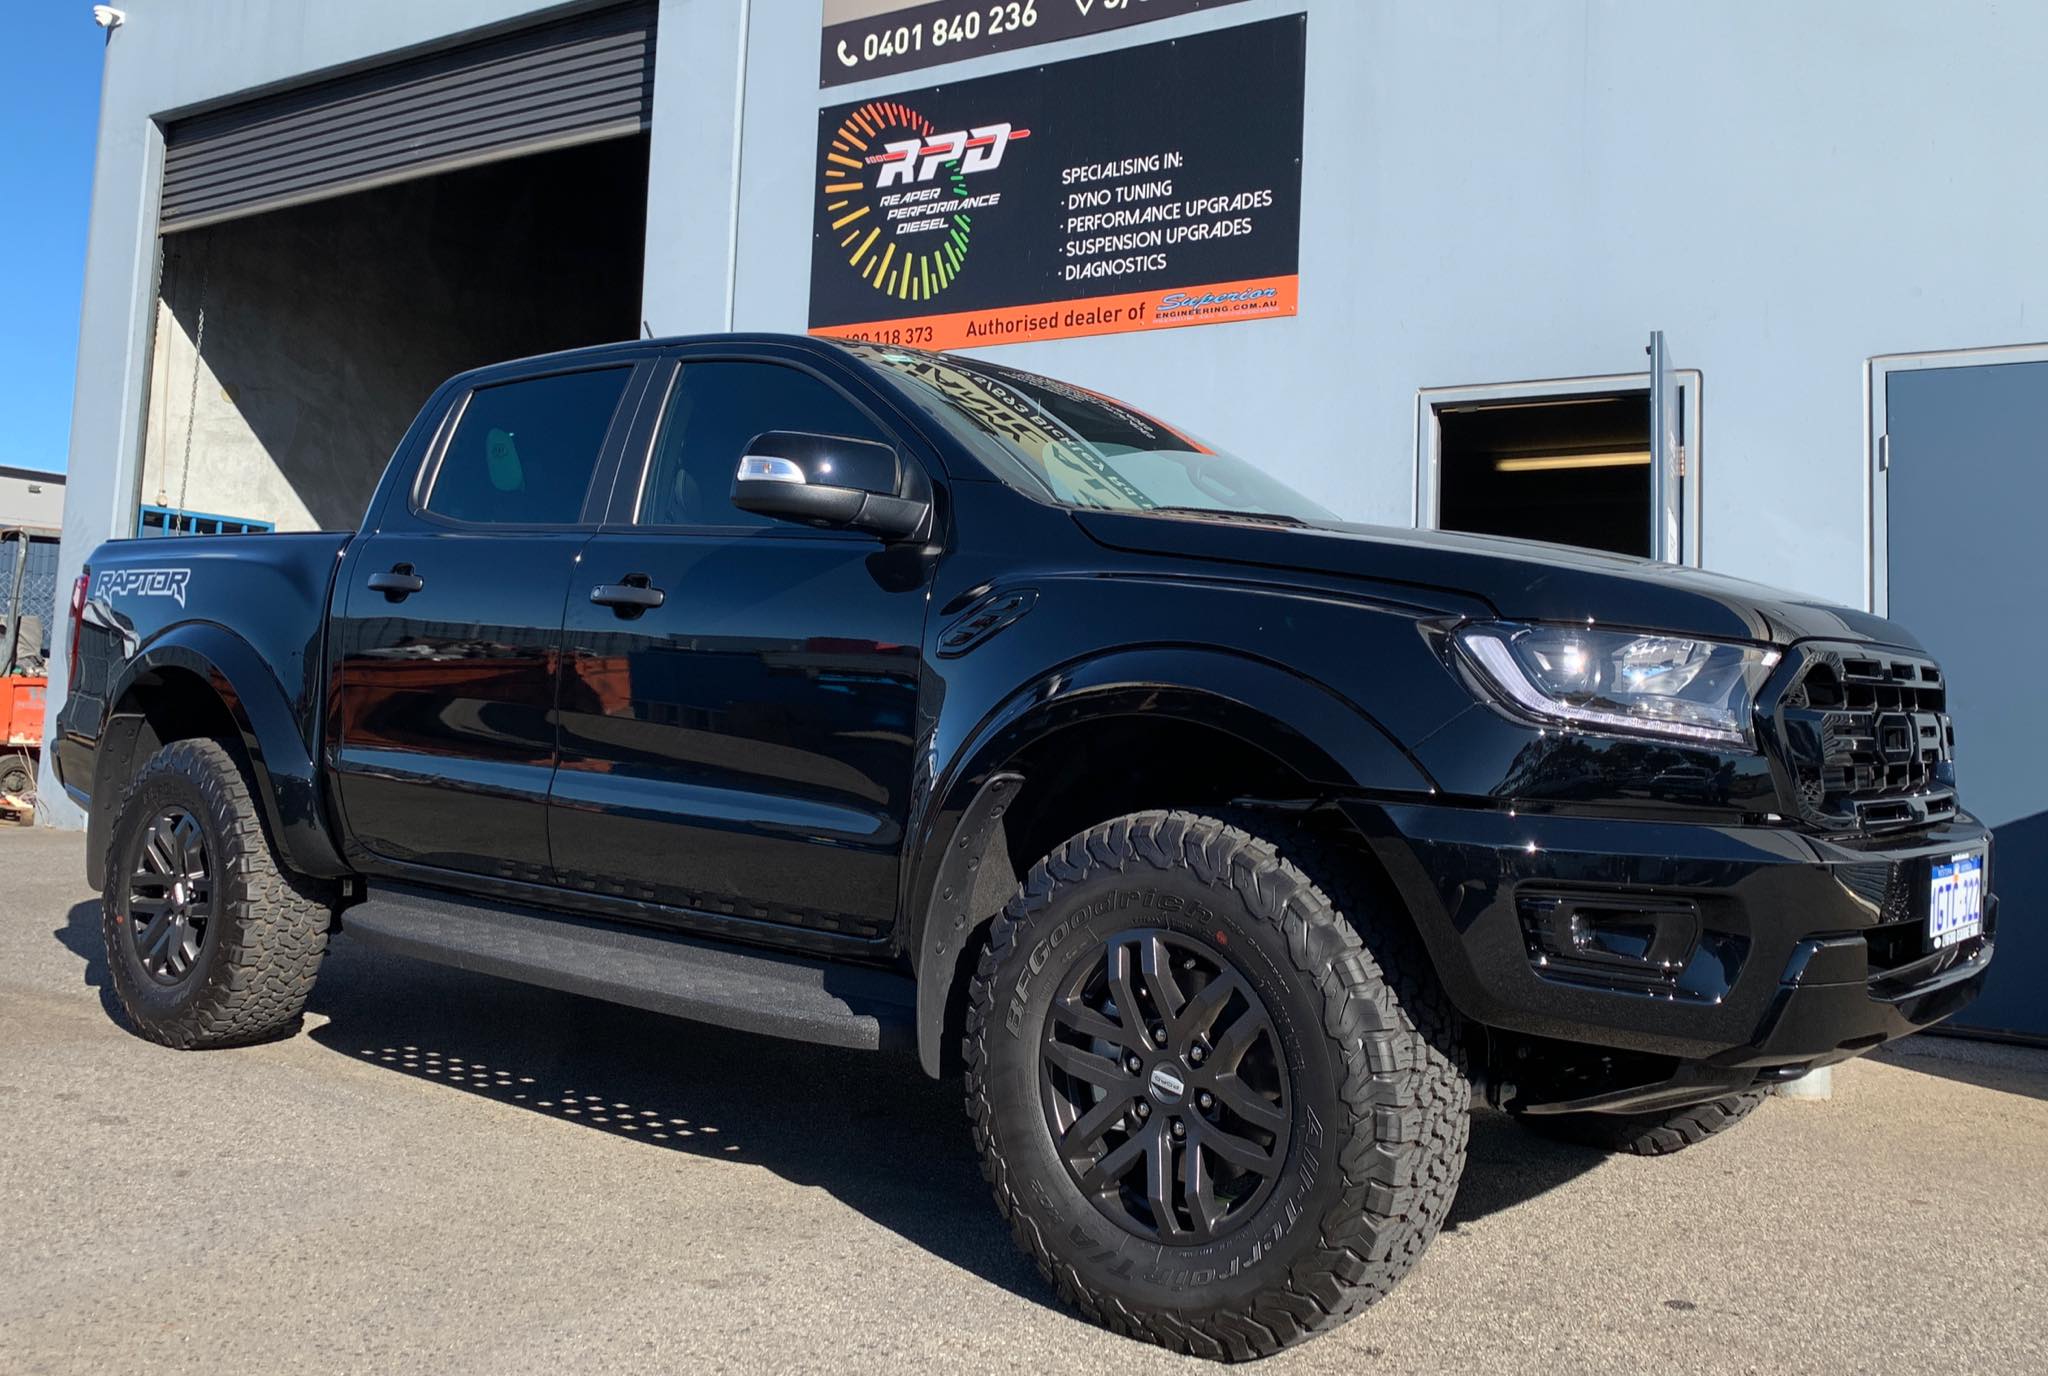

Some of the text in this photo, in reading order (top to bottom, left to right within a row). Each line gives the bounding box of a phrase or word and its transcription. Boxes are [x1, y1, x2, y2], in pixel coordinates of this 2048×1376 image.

[863, 0, 1038, 62] 0401 840 236
[876, 122, 1012, 189] RPD
[1062, 152, 1183, 184] SPECIALISING IN:
[880, 188, 942, 207] REAPER
[887, 193, 1001, 221] PERFORMANCE
[1068, 180, 1173, 210] DYNO TUNING
[896, 218, 949, 235] DIESEL
[1067, 190, 1273, 233] PERFORMANCE UPGRADES
[1066, 218, 1252, 257] SUSPENSION UPGRADES
[1065, 253, 1168, 281] DIAGNOSTICS
[1155, 300, 1278, 319] ENGINEERING.COM.AU
[1157, 287, 1277, 312] Superior
[905, 326, 933, 344] 373
[966, 311, 1059, 338] Authorised
[1064, 306, 1122, 329] dealer
[1128, 302, 1146, 322] of
[95, 568, 191, 609] RAPTOR
